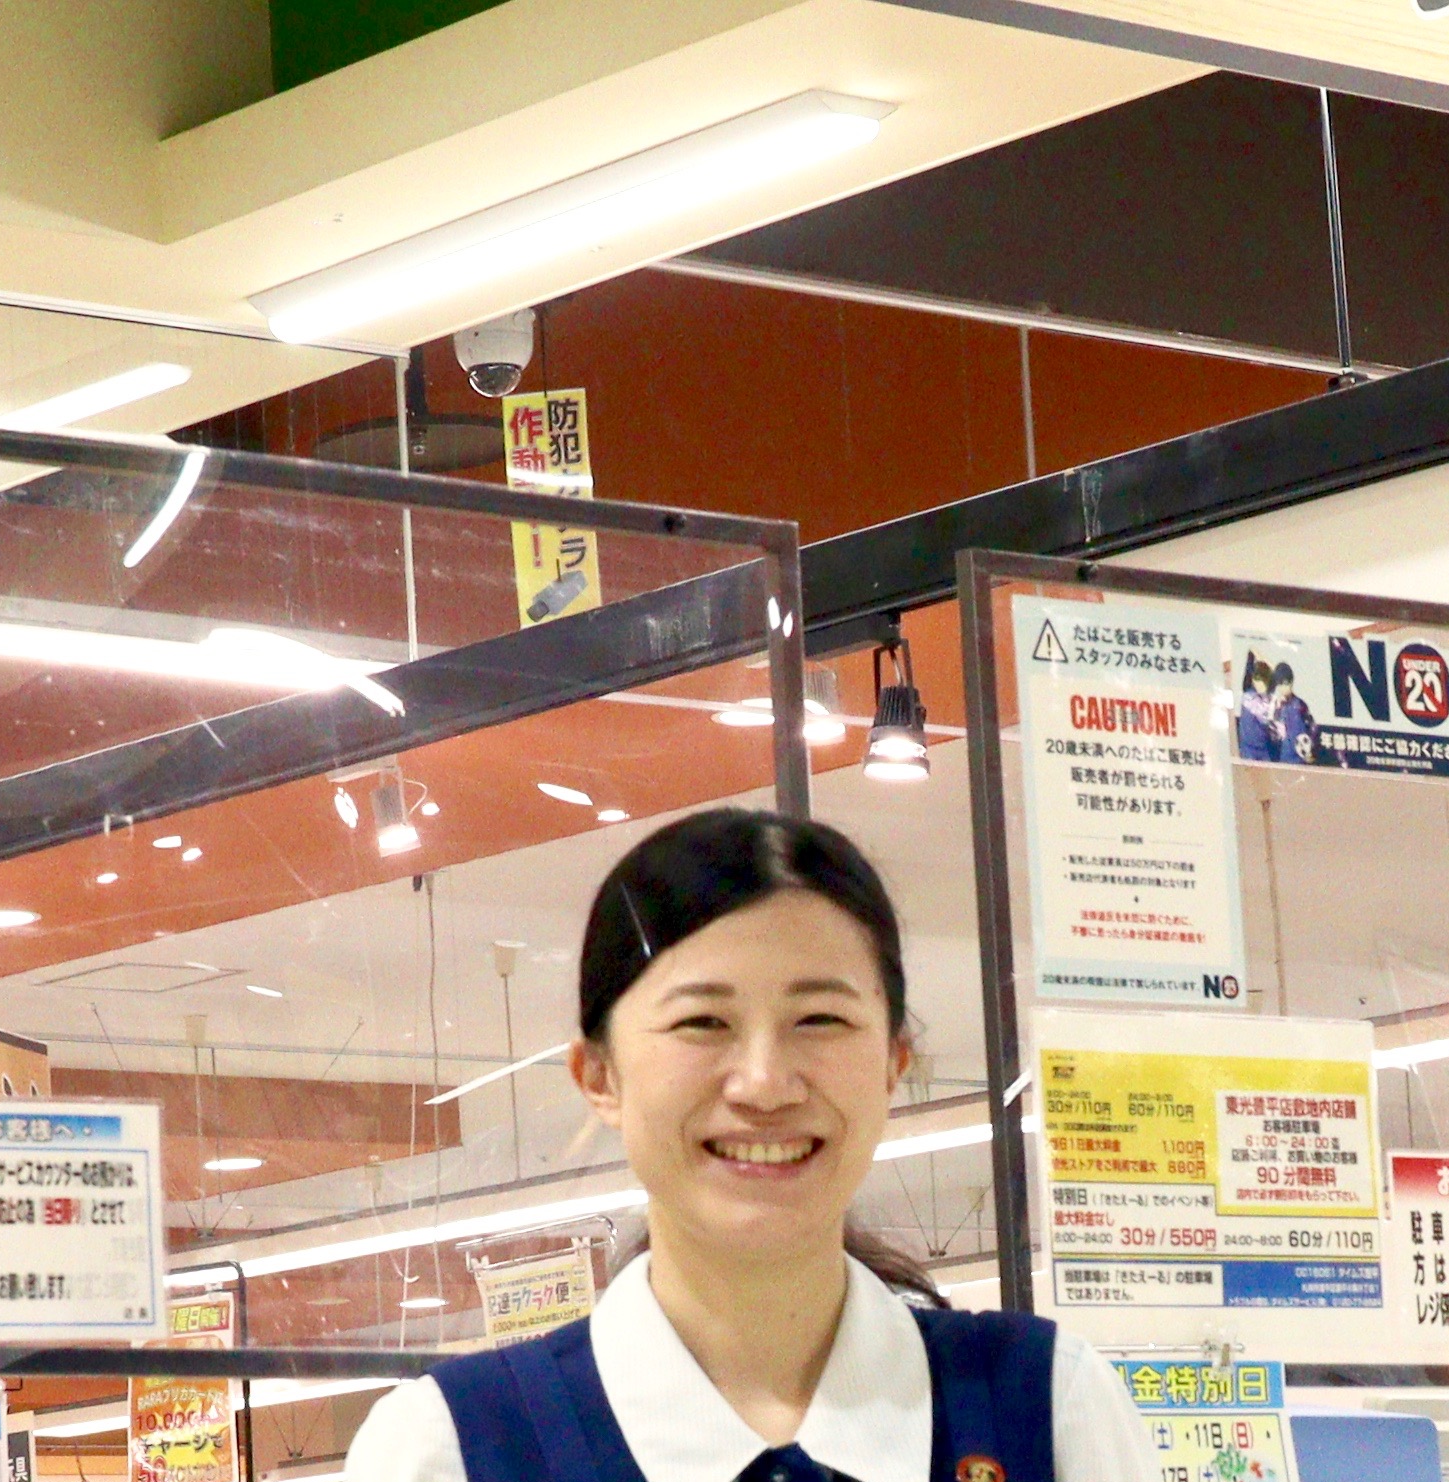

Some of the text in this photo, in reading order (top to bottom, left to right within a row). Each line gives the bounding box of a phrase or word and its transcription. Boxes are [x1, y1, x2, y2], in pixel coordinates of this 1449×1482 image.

[1073, 624, 1182, 651] たばこを販売する
[1075, 647, 1206, 674] スタッフのみなさまへ
[1402, 656, 1441, 673] UNDER
[1070, 694, 1177, 738] CAUTION!
[1046, 737, 1206, 766] 20歳未満へのたばこ販売は
[1070, 766, 1186, 791] 販売者が罰せられる
[1076, 793, 1184, 816] 可能性があります。
